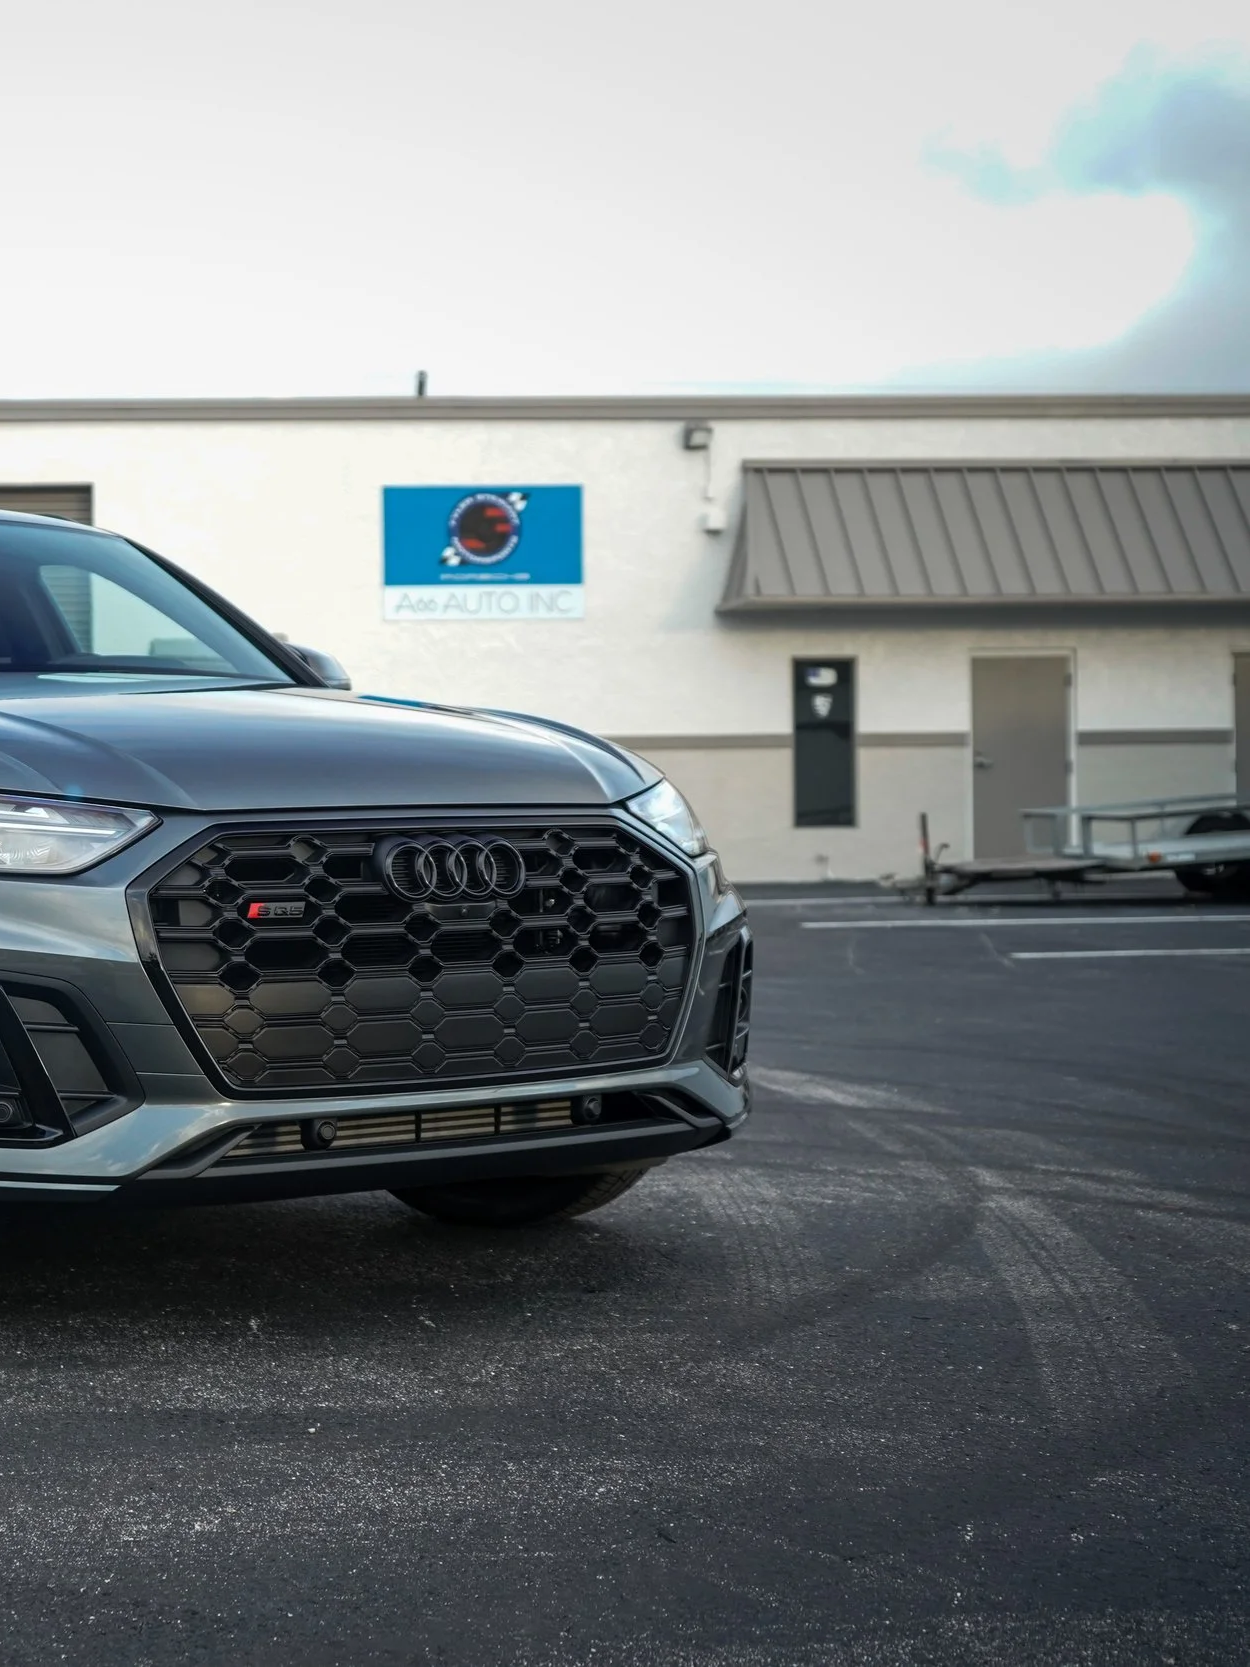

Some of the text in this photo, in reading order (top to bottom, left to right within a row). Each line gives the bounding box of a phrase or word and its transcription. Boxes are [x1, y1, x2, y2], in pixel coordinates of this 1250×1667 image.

[442, 590, 519, 615] AUTO
[529, 590, 574, 614] INC
[256, 904, 304, 917] SQ5
